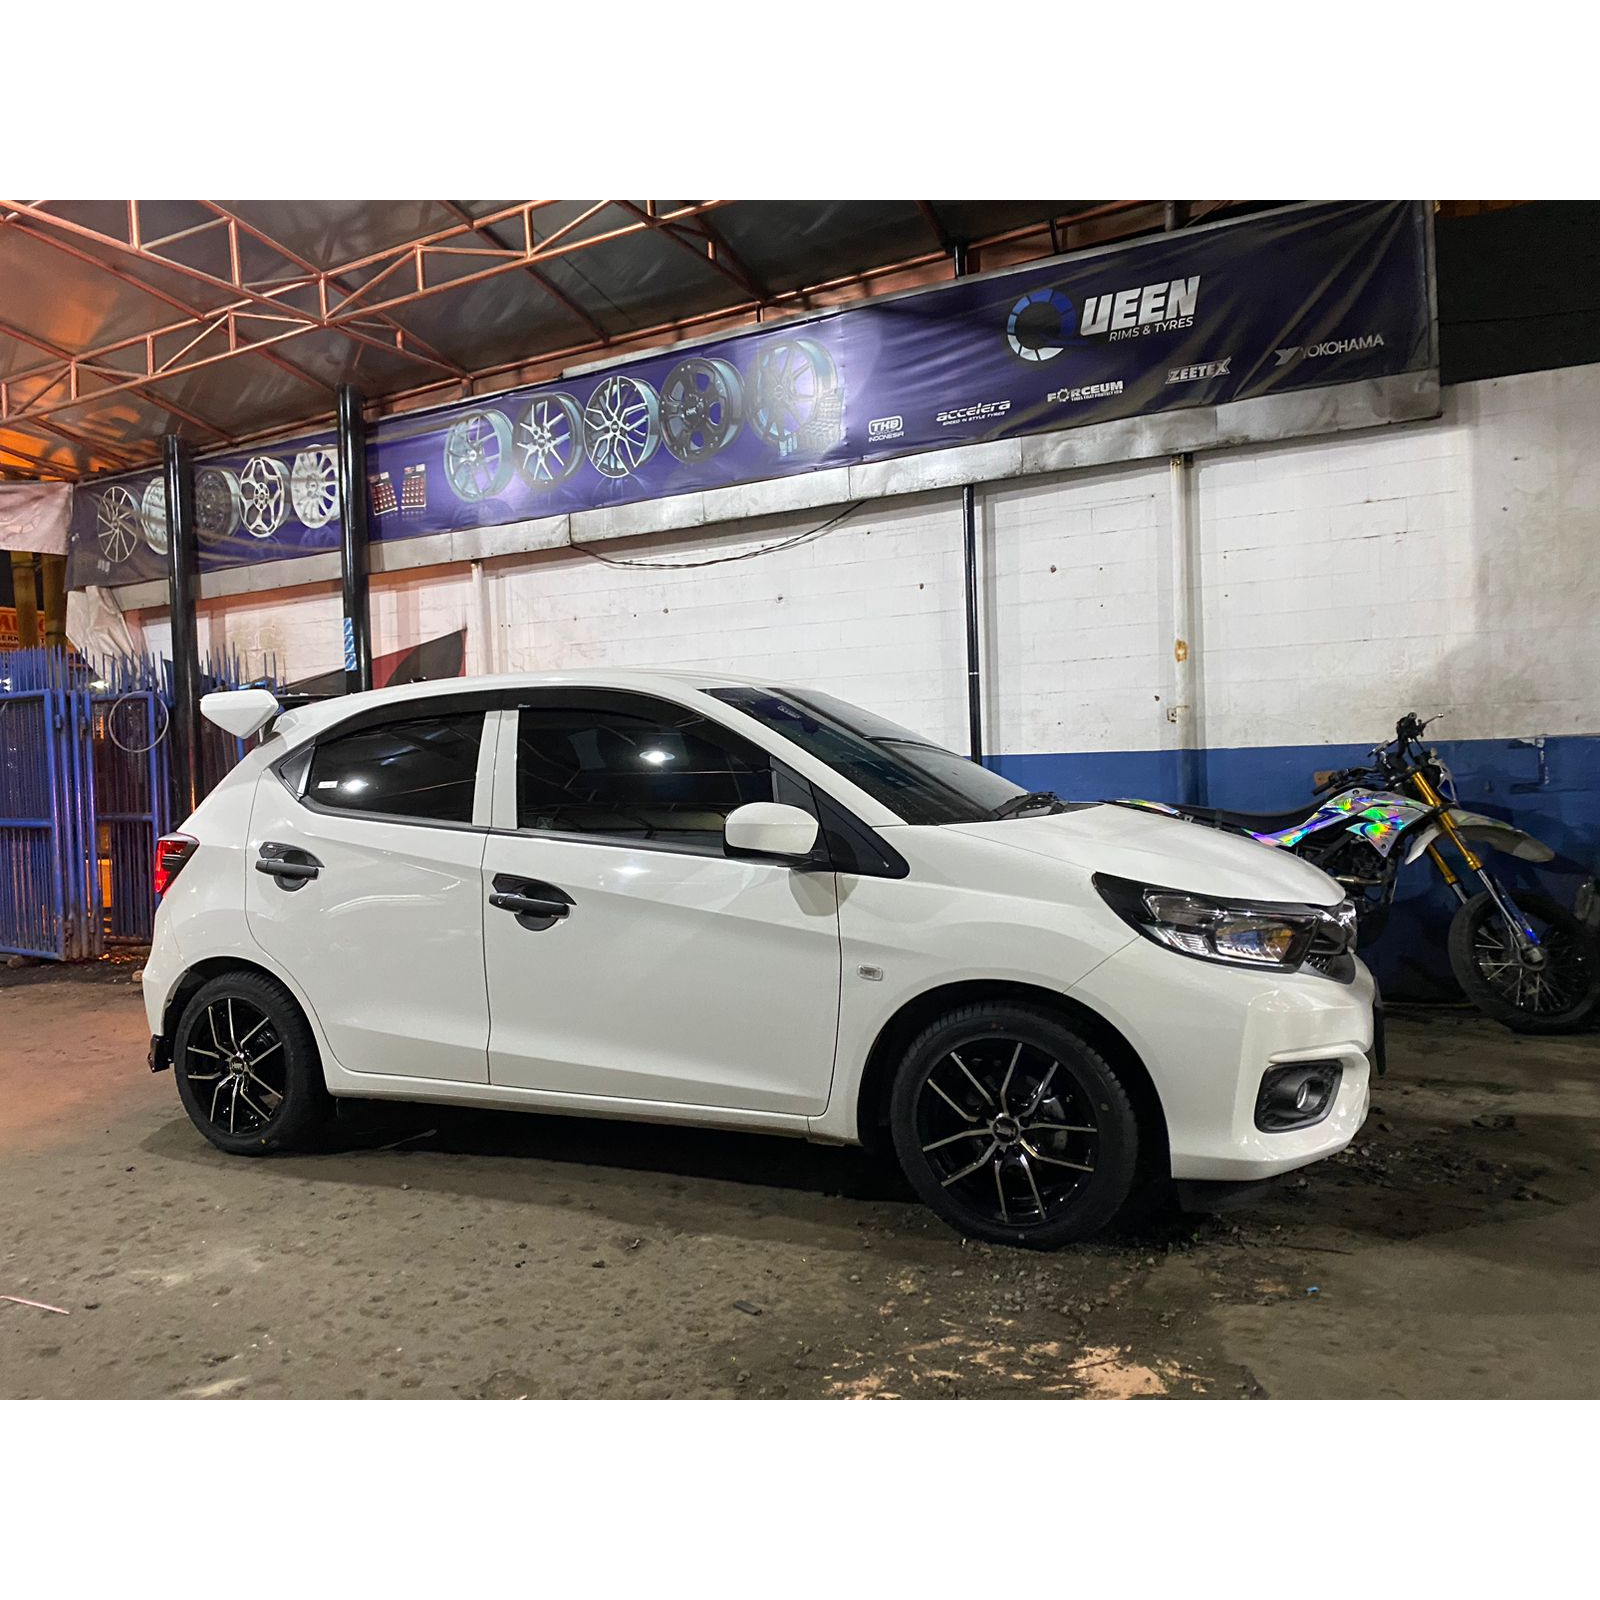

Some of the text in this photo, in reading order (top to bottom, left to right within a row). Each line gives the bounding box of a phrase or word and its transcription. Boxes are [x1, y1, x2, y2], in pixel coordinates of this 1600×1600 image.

[1109, 316, 1194, 342] RIMS & TYRES
[1168, 357, 1232, 382] ZEETEX
[1047, 380, 1124, 402] FORCEUM
